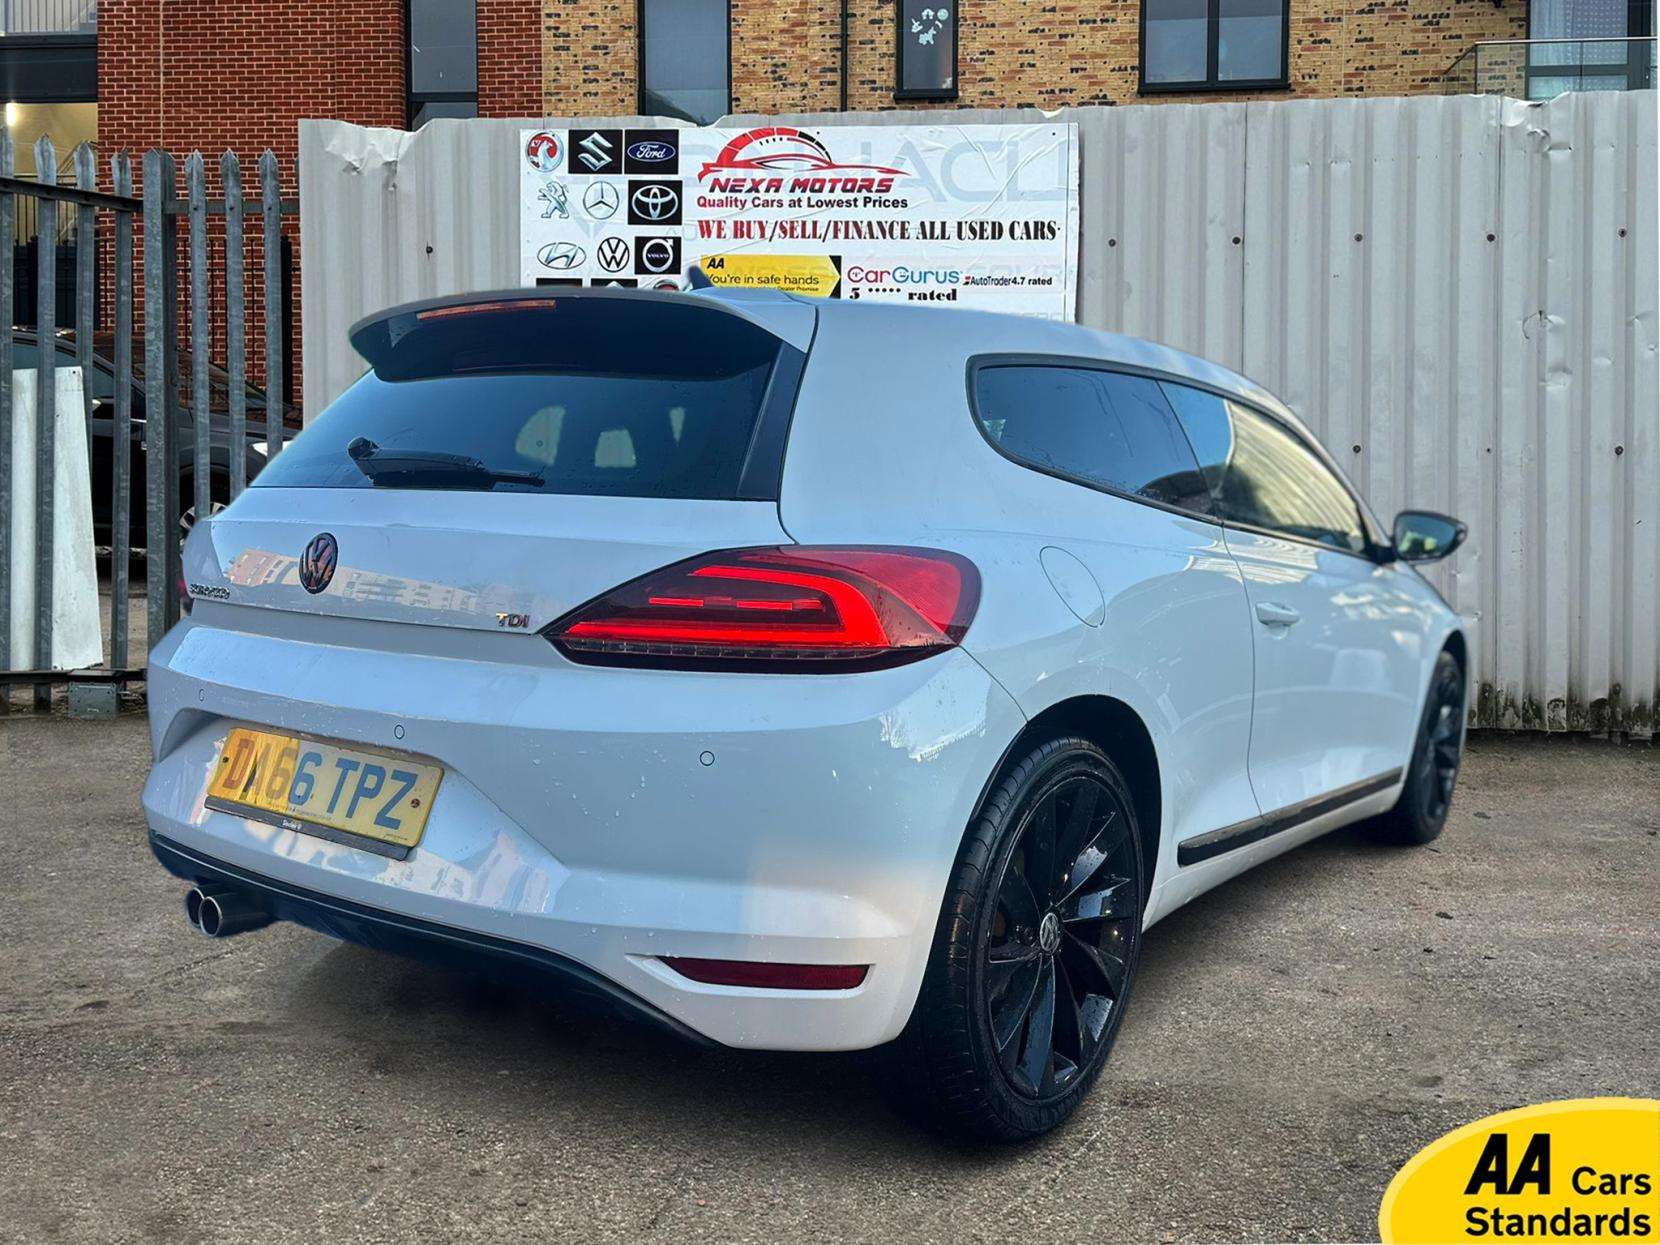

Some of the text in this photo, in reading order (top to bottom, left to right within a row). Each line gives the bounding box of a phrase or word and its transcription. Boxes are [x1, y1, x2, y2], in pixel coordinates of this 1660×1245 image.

[636, 144, 666, 158] Ford
[709, 178, 895, 193] NEXA MOTORS
[697, 196, 908, 210] Quality Cars at Lowest Prices
[698, 220, 726, 240] WE
[916, 221, 951, 240] ALL
[956, 220, 1004, 241] USED
[1009, 220, 1057, 241] CARS
[707, 258, 724, 269] AA
[744, 274, 754, 284] in
[757, 274, 781, 284] safe
[784, 275, 819, 285] hands
[1028, 277, 1053, 286] rated
[908, 288, 957, 301] rated
[496, 612, 530, 628] TDI
[326, 757, 419, 831] TPZ
